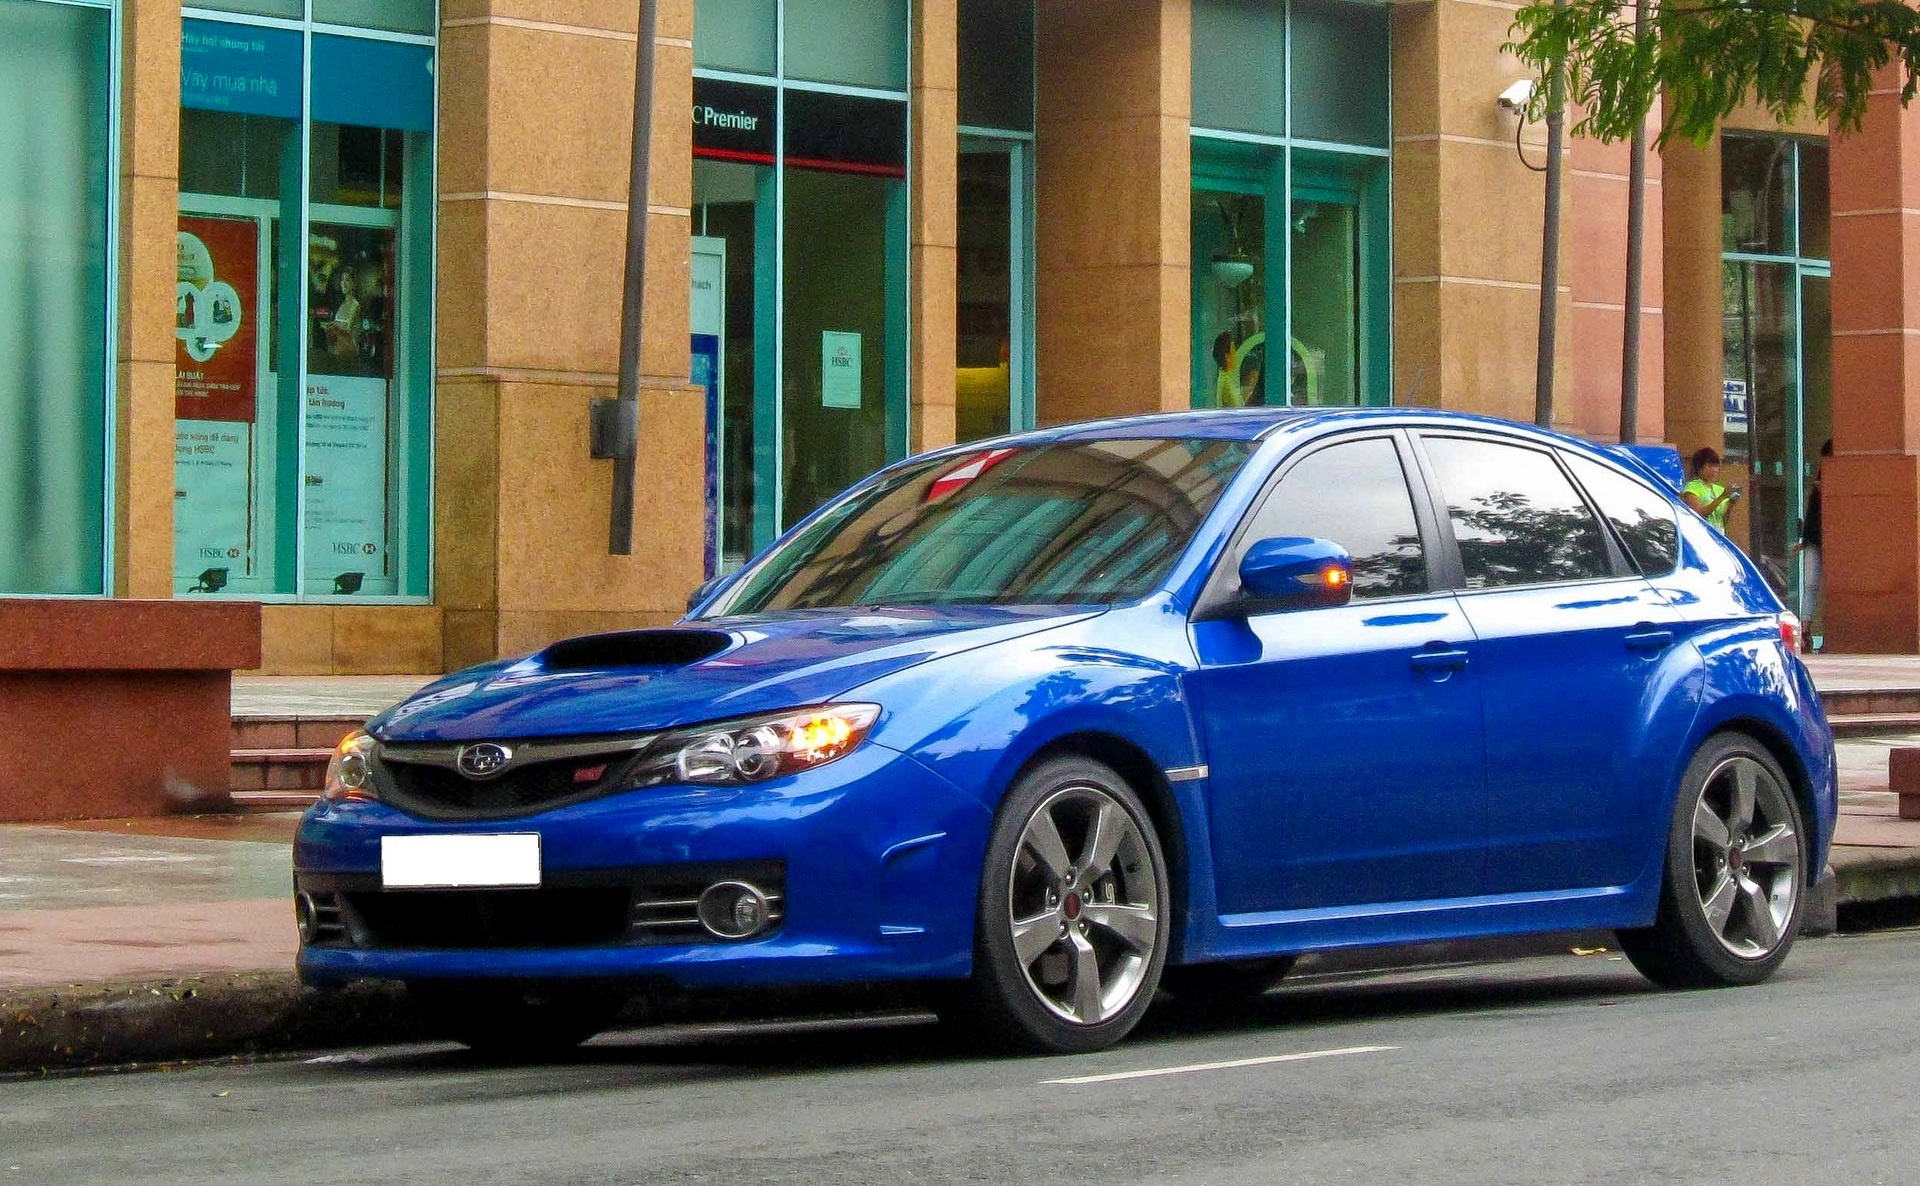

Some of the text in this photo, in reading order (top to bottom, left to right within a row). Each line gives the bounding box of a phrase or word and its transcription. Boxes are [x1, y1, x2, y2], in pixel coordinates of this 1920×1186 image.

[704, 106, 758, 131] Premier
[831, 356, 853, 367] HSBC
[199, 547, 224, 559] HSBC
[331, 542, 361, 555] HSBC
